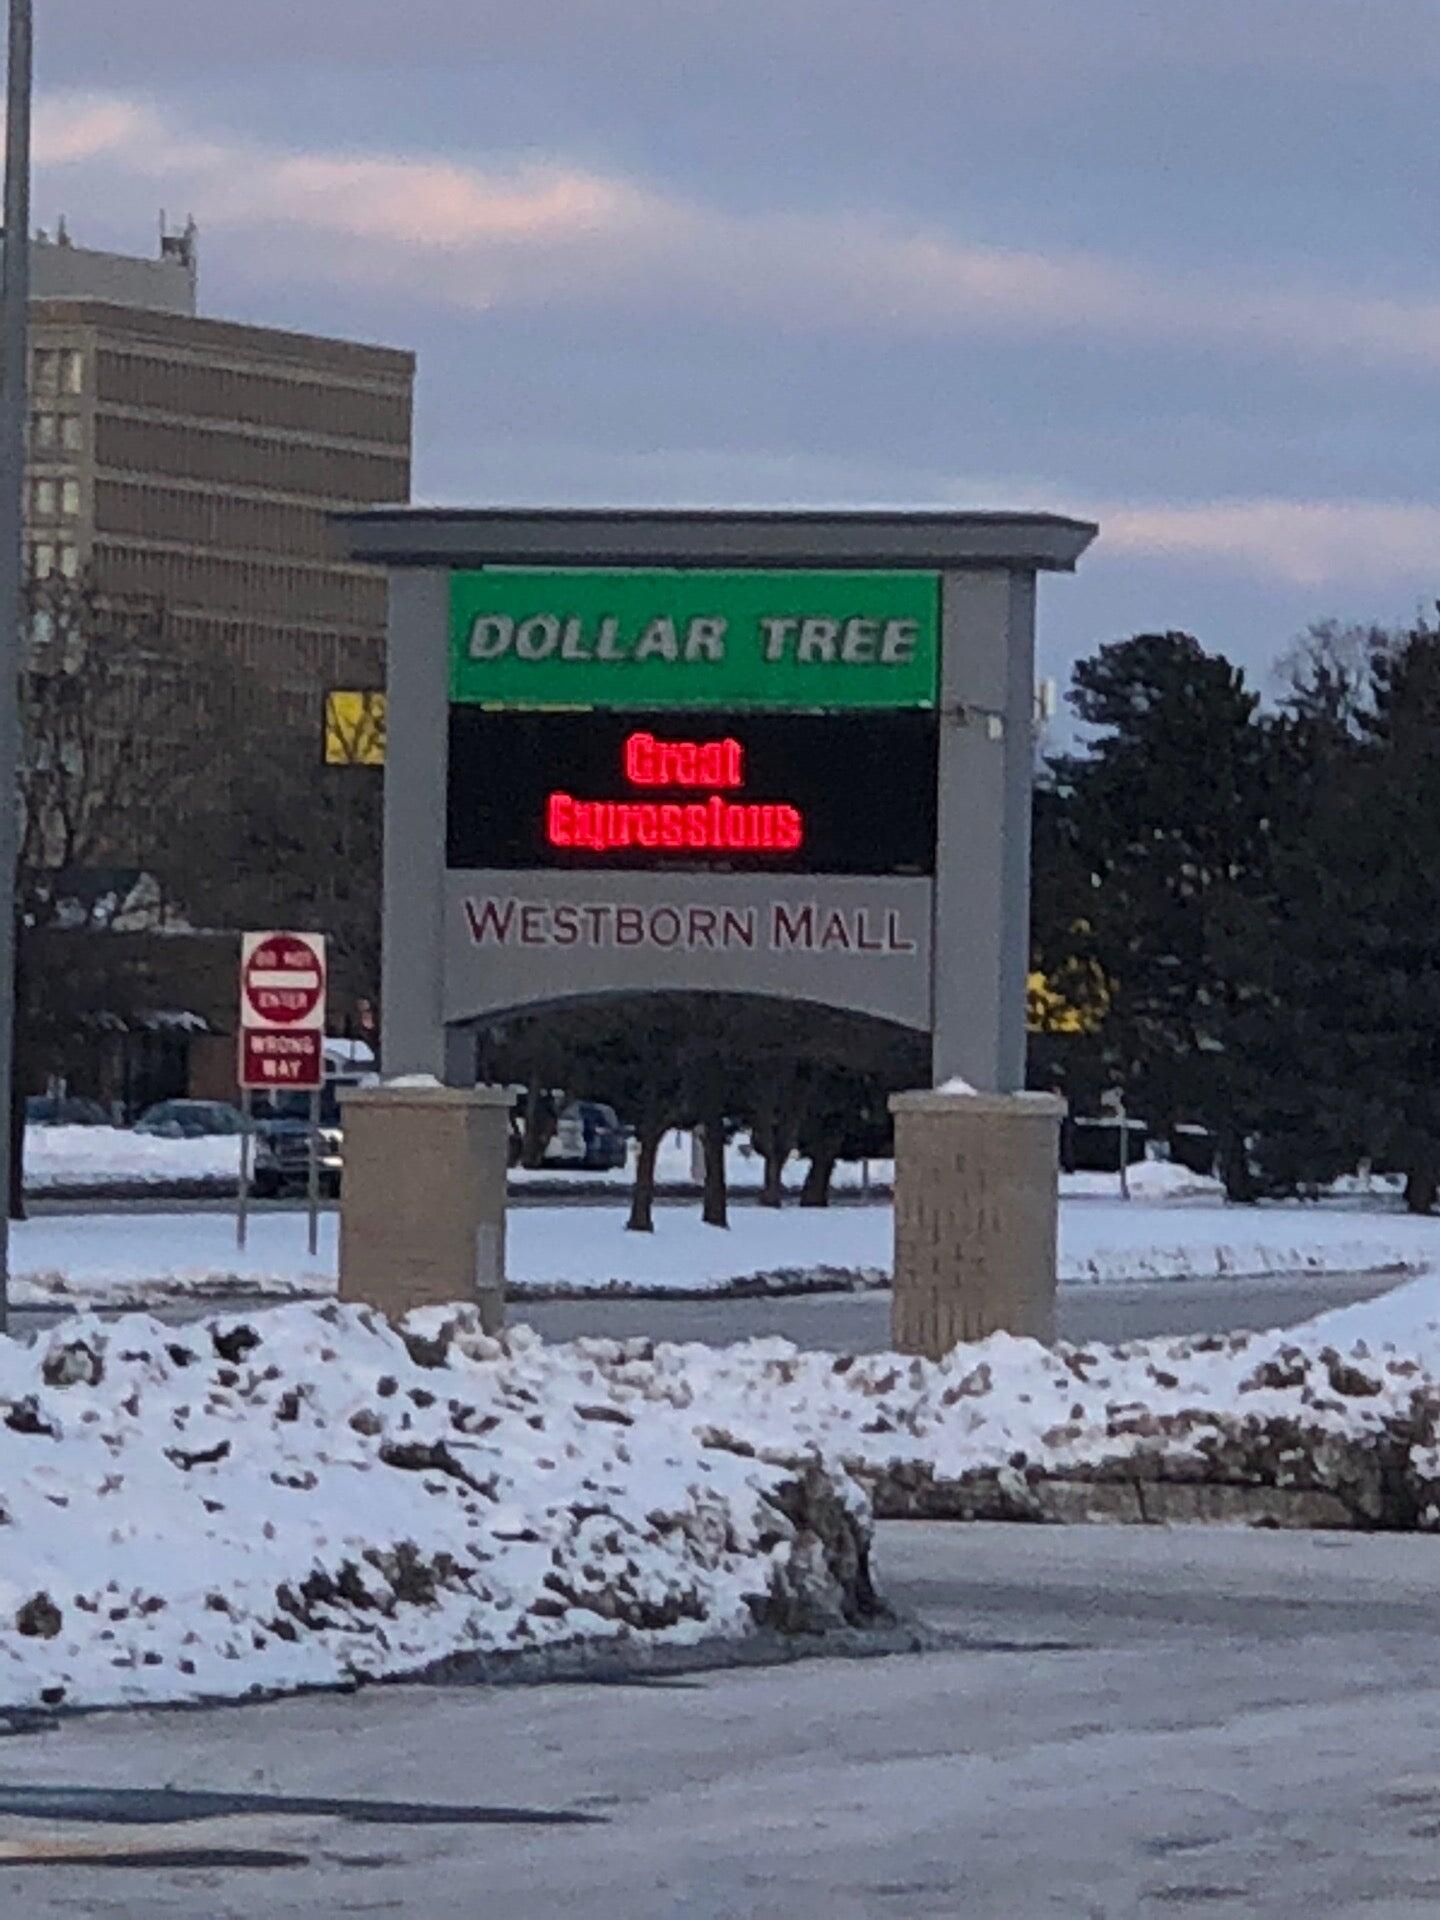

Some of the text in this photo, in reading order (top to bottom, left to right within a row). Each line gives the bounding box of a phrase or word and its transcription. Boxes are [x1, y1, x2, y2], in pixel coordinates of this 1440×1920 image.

[468, 613, 918, 663] DOLLAR TREE
[625, 732, 743, 786] Great
[548, 794, 802, 850] Expressions
[463, 898, 915, 951] WESTBORN MALL
[250, 1035, 315, 1054] WRONG
[262, 1059, 302, 1077] WAY
